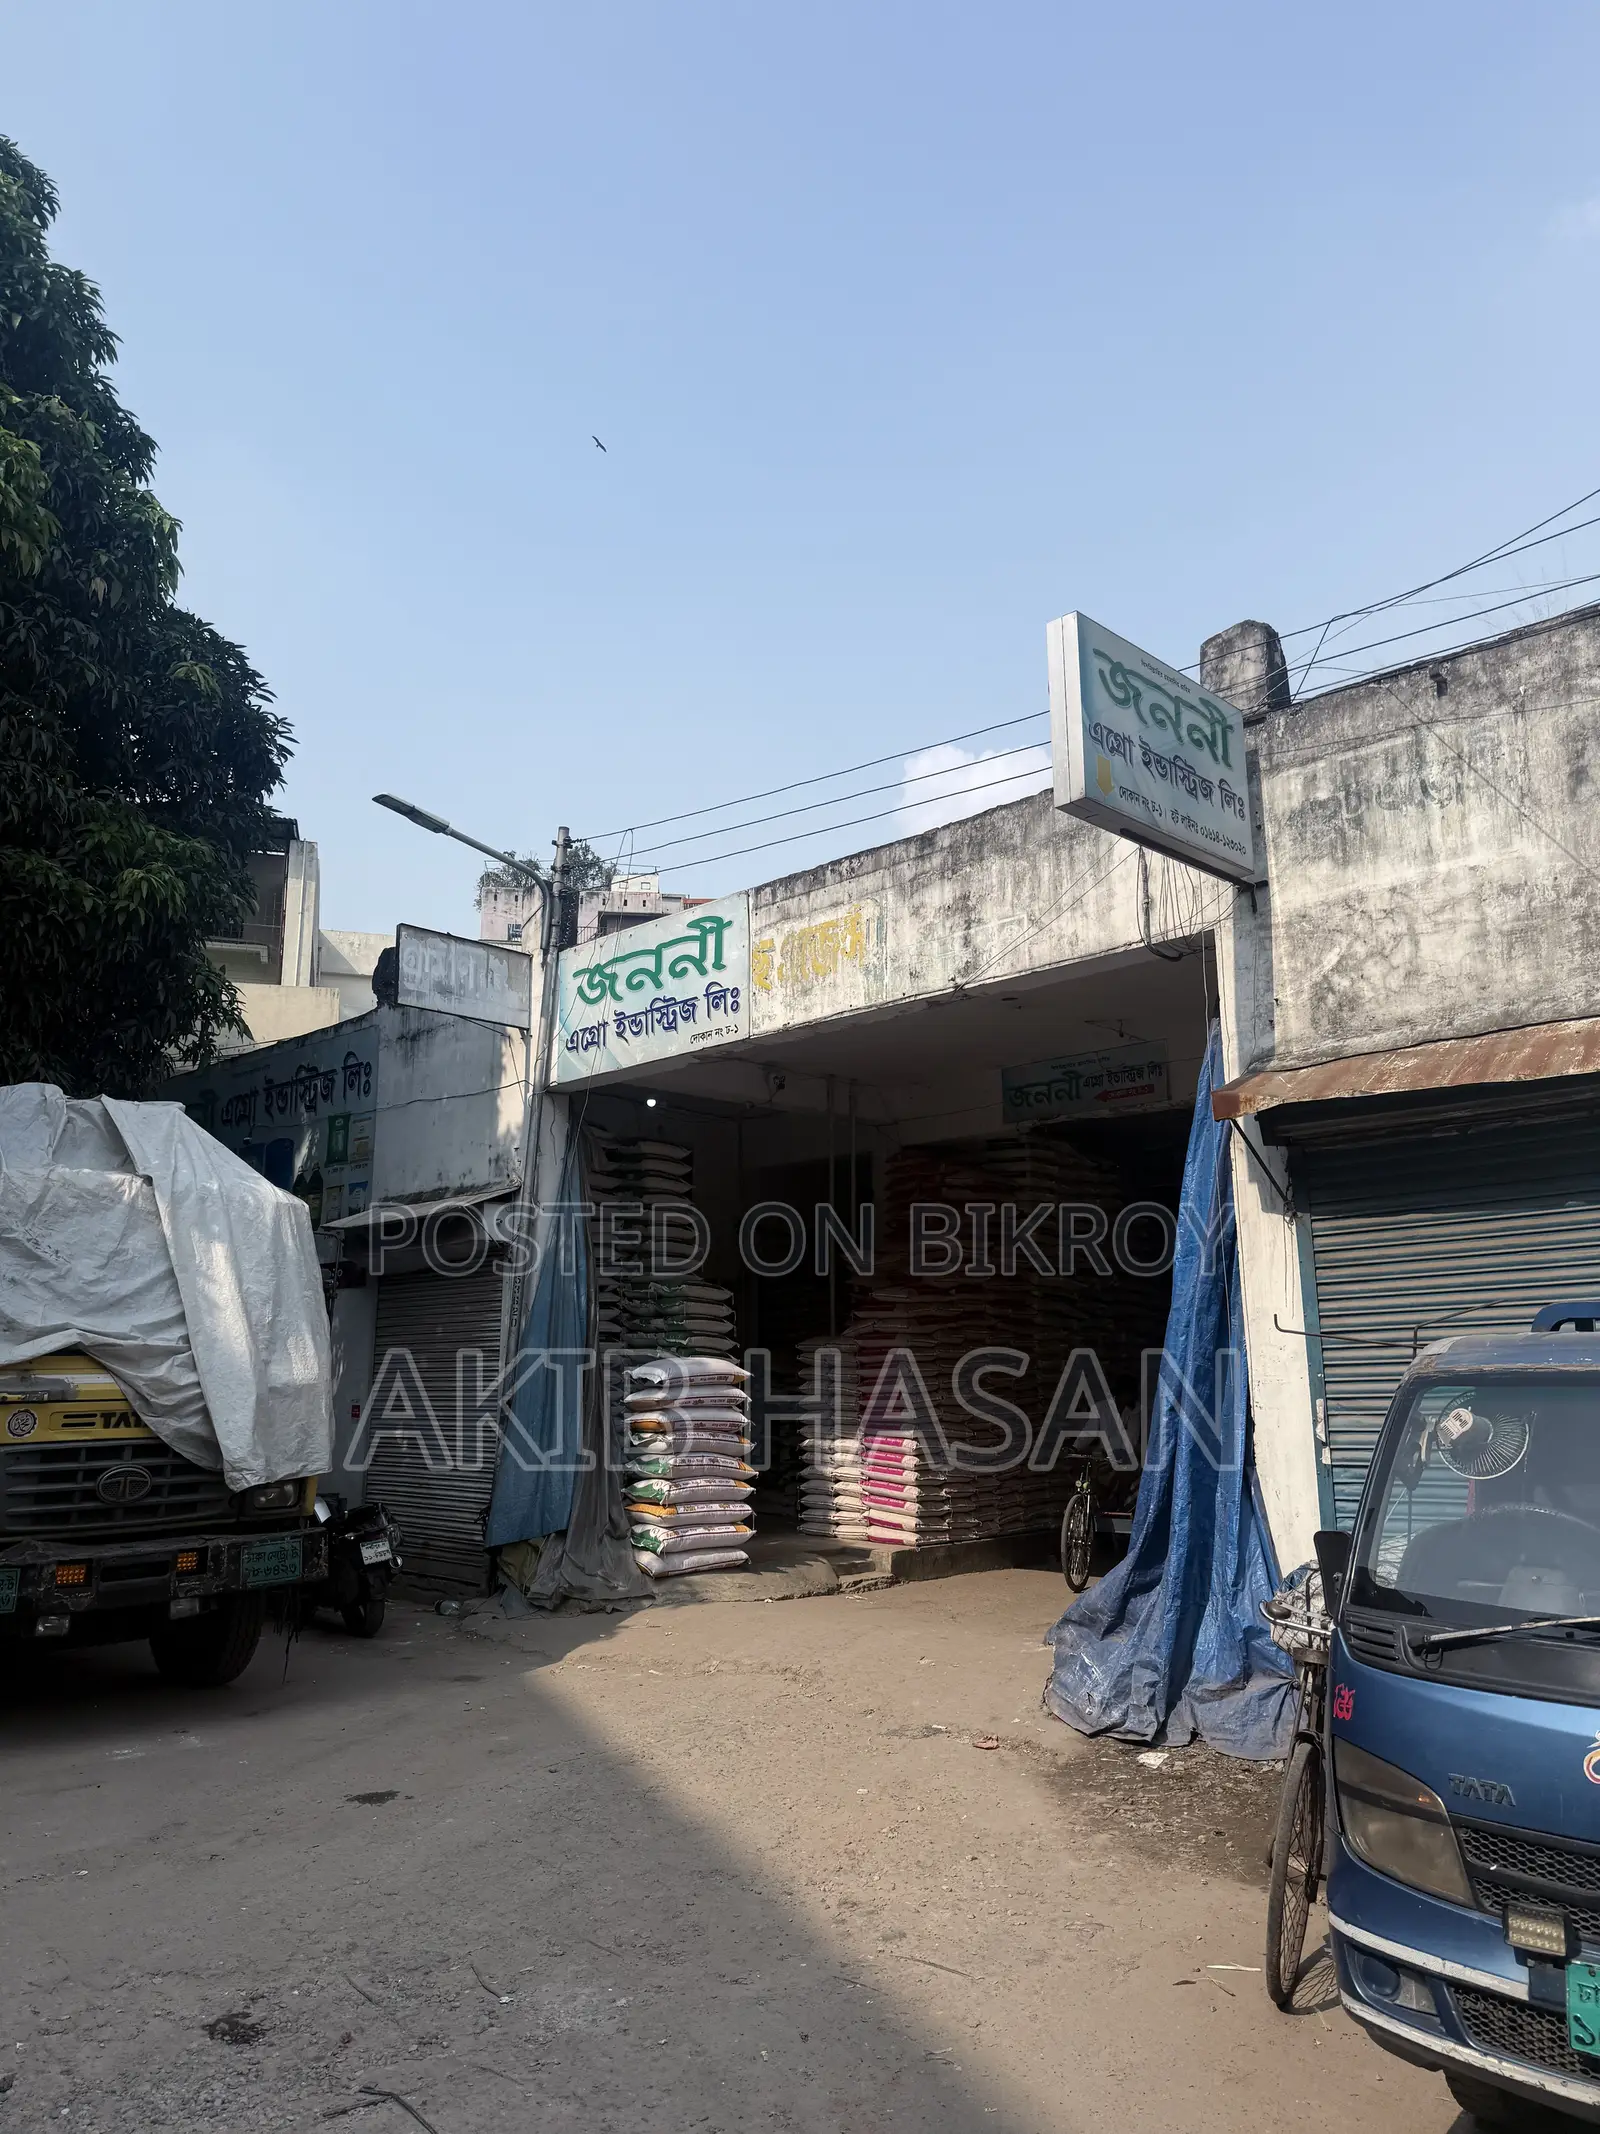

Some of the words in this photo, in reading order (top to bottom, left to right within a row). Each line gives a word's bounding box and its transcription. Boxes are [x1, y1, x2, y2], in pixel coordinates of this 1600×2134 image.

[1092, 647, 1235, 769] জননী
[1088, 720, 1134, 765] এগ্রো
[572, 914, 733, 1005] জননী
[566, 1020, 609, 1054] এগ্রো
[690, 1029, 713, 1044] দোকান
[1447, 1772, 1517, 1808] TATA
